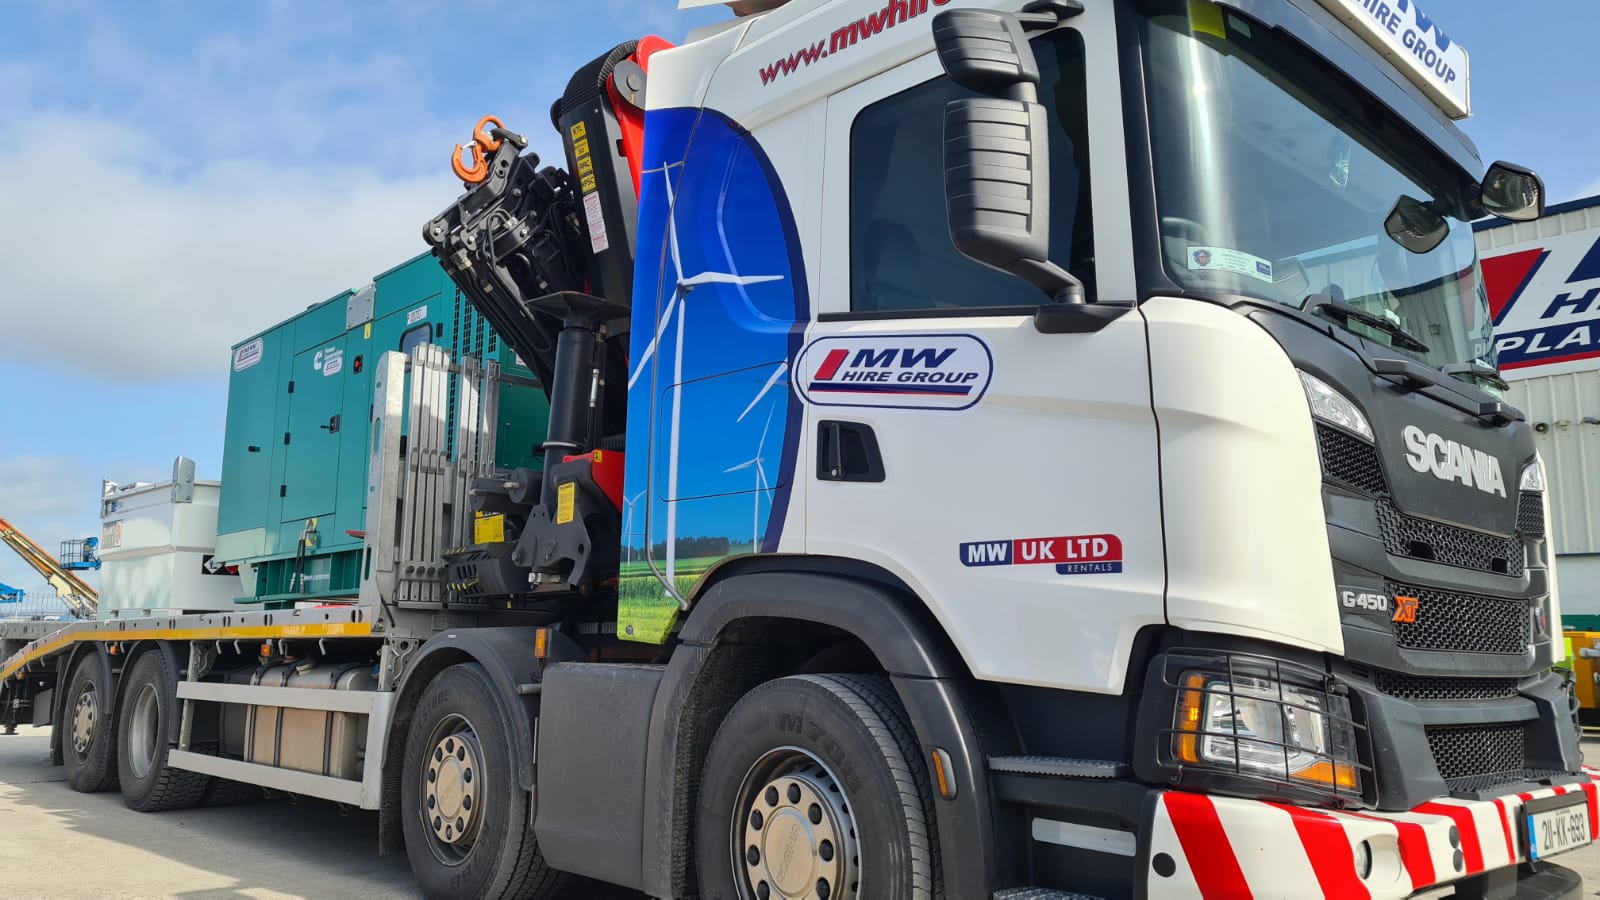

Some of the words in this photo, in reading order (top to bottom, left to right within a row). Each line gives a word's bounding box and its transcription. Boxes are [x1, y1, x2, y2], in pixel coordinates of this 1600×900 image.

[1402, 28, 1456, 84] GROUP
[849, 348, 958, 369] MW
[841, 371, 893, 382] HIRE
[896, 371, 980, 384] GROUP
[1402, 424, 1508, 499] SCANIA
[968, 543, 1008, 563] MW
[1021, 540, 1056, 561] UK
[1066, 537, 1110, 560] LTD
[1067, 562, 1114, 573] RENTALS
[1392, 595, 1419, 623] XT
